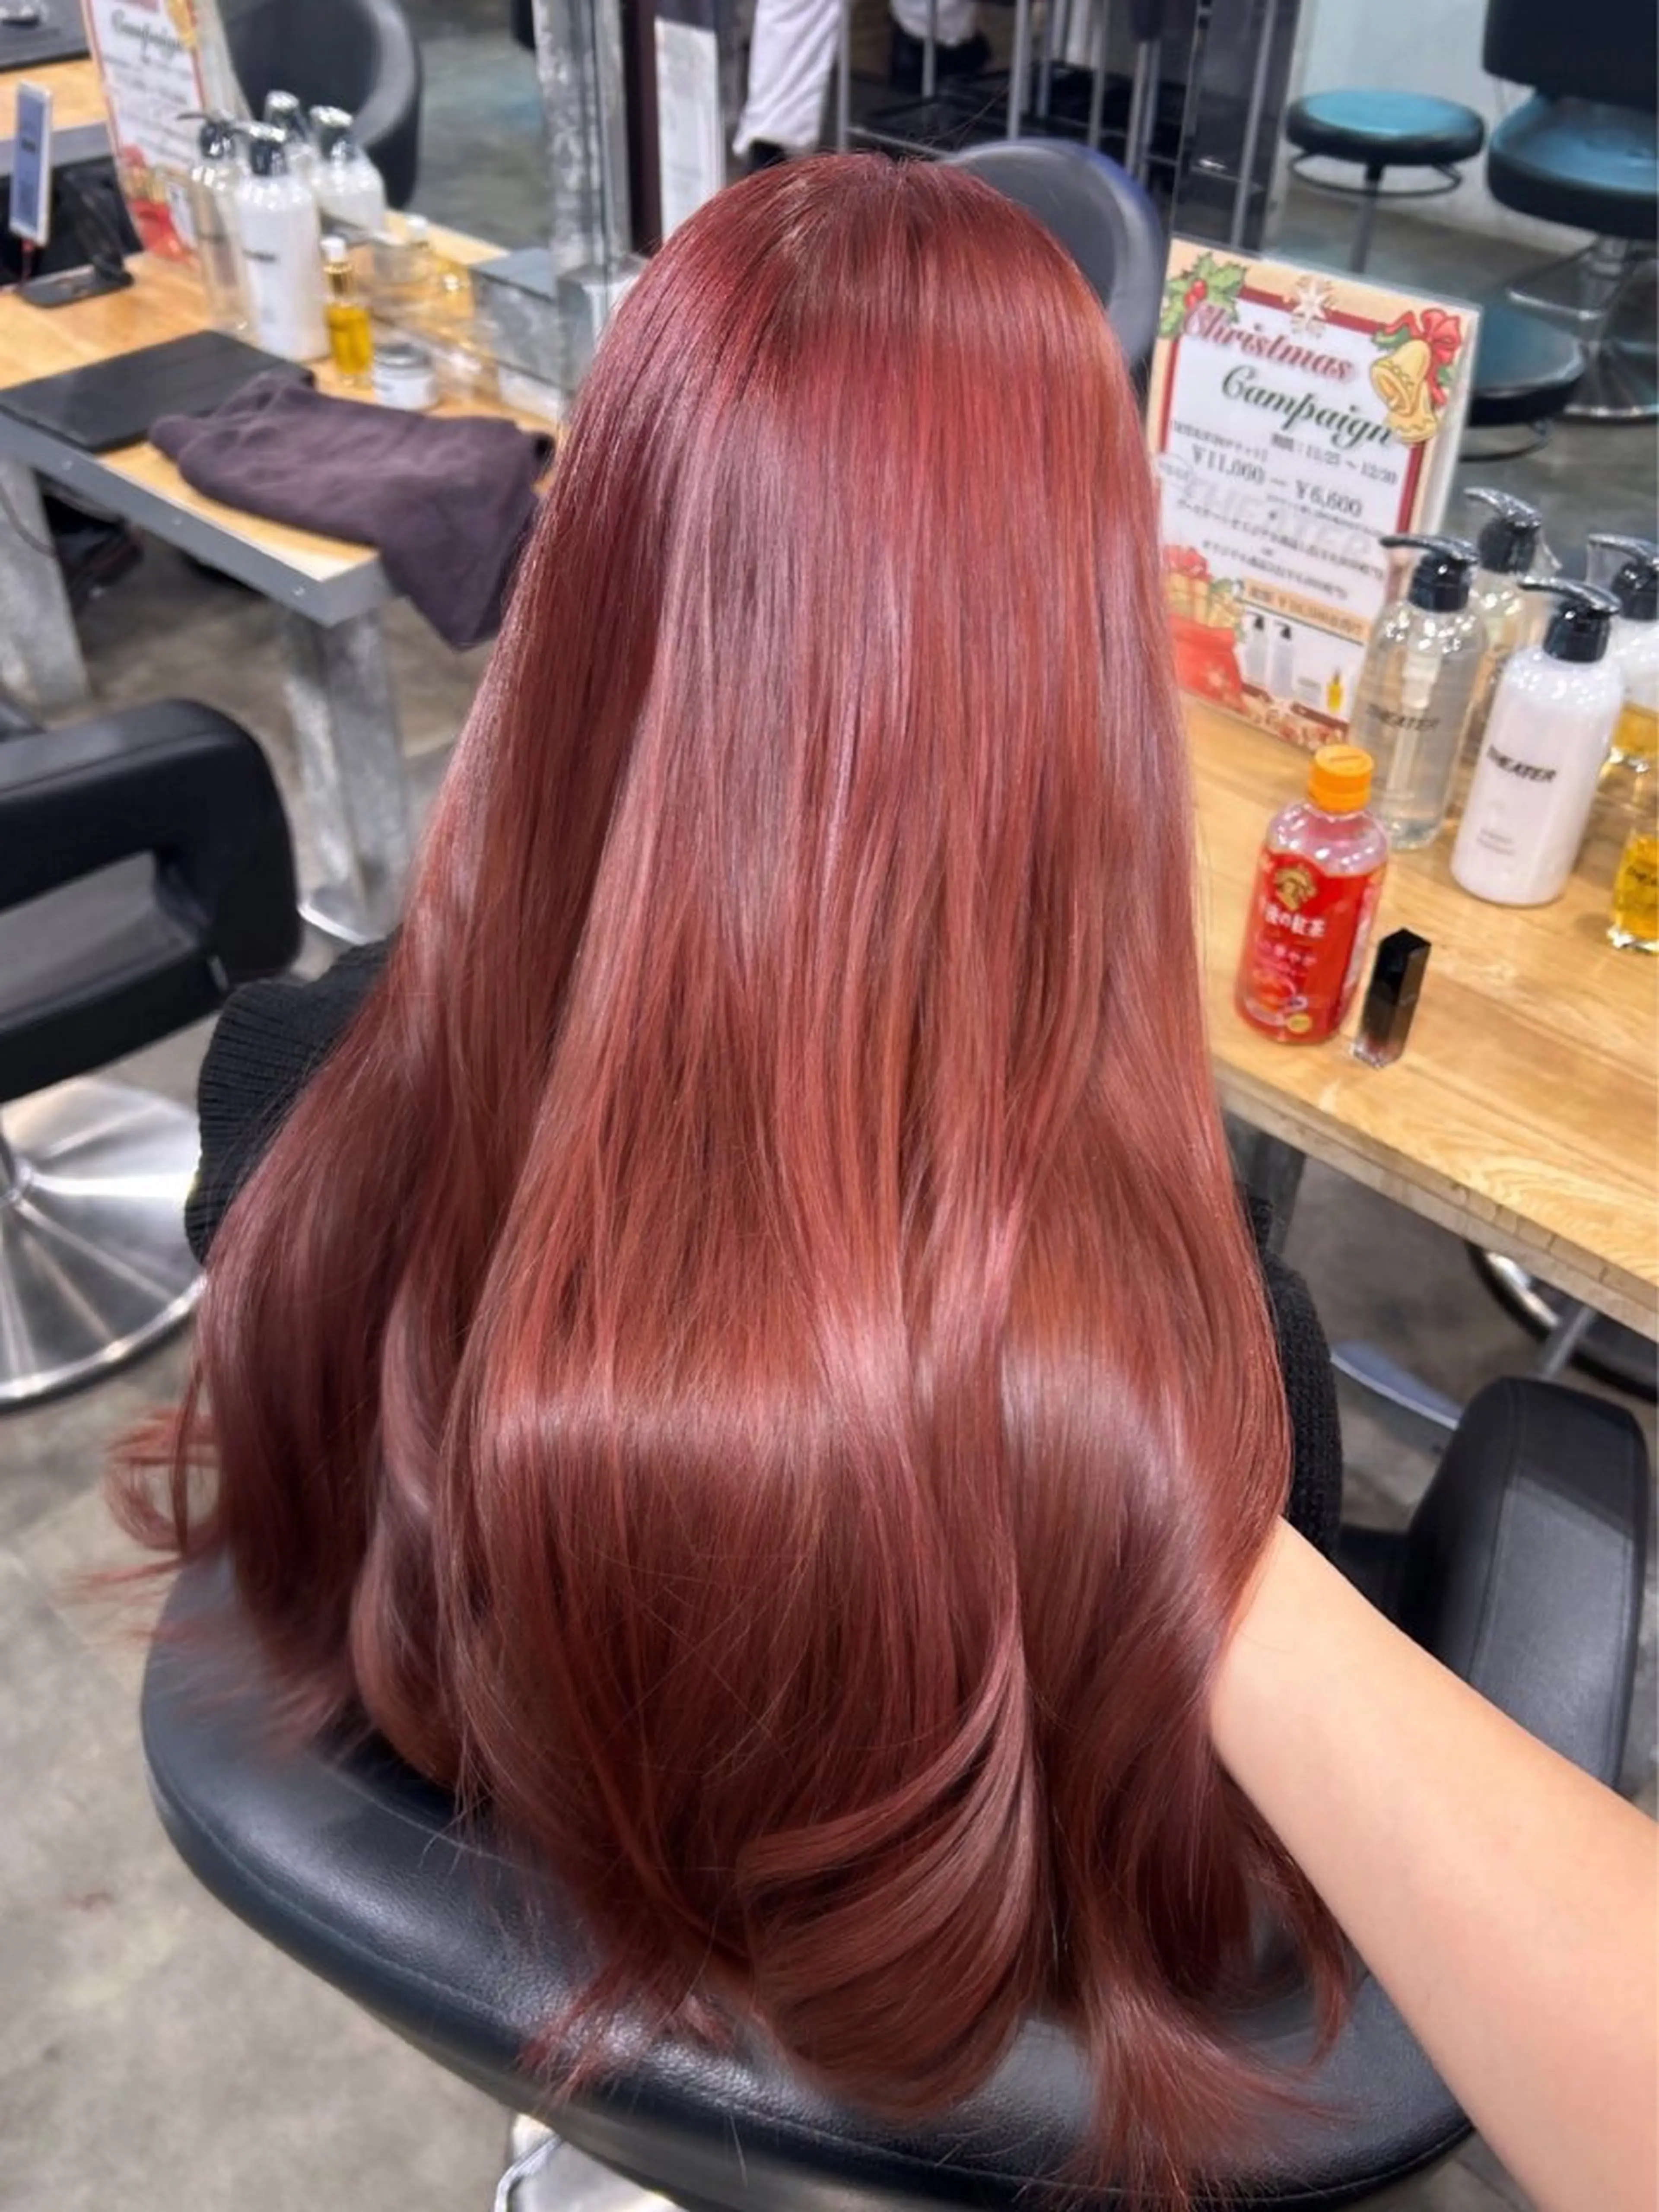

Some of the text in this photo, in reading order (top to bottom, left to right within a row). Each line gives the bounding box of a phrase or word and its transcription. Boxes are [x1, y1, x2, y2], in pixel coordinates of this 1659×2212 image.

[1185, 303, 1354, 381] Christmas
[1222, 365, 1393, 450] Campaign
[1486, 744, 1557, 784] THEATER
